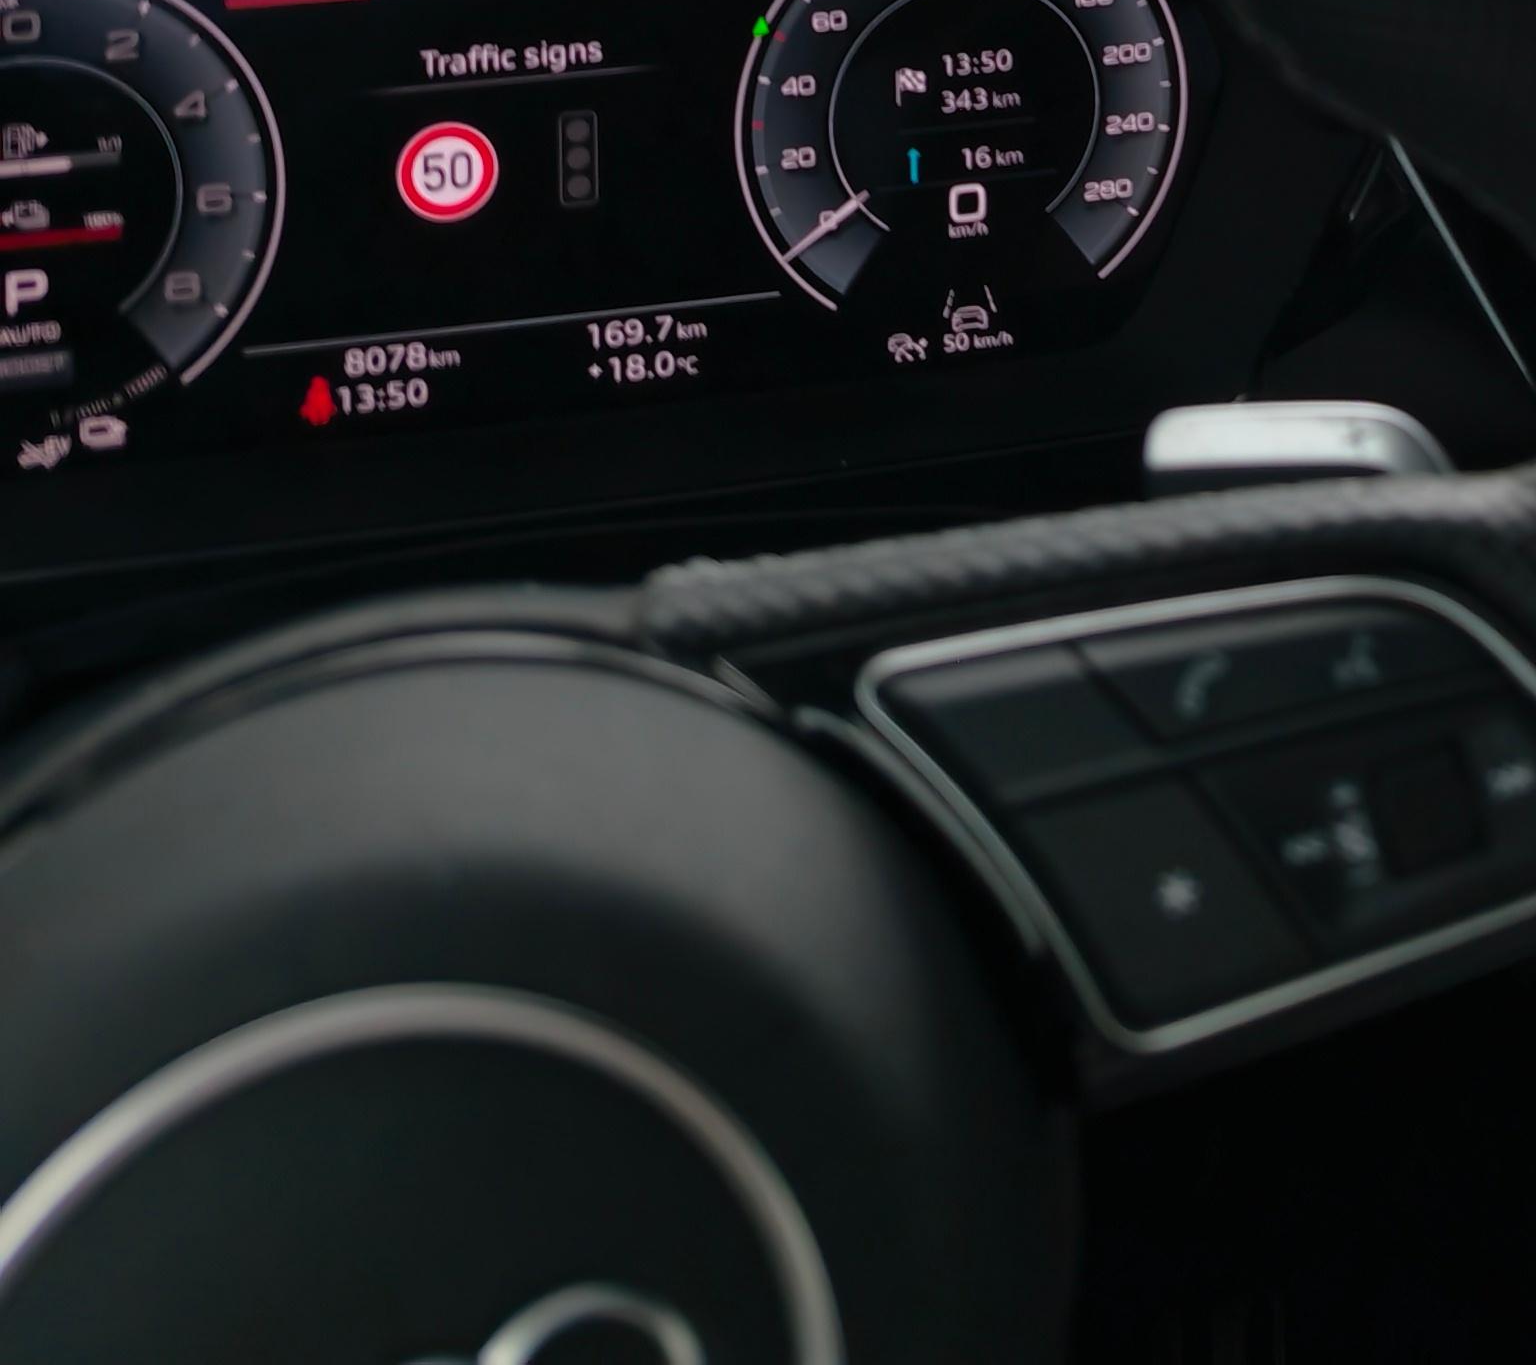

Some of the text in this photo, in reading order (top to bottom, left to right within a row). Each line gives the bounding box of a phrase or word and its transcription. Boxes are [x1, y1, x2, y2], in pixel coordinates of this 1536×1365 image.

[811, 10, 848, 32] 60
[104, 29, 140, 61] 2
[1103, 42, 1152, 65] 200
[420, 40, 603, 79] Traffic signs
[942, 48, 1013, 76] 13:50
[781, 76, 816, 97] 40
[174, 92, 206, 121] 4
[940, 88, 1021, 113] 343 km
[1105, 111, 1155, 135] 240
[781, 147, 816, 169] 20
[961, 147, 1024, 169] 16 km
[422, 151, 474, 193] 50
[948, 183, 987, 225] 0
[948, 222, 989, 240] km/h
[5, 268, 49, 317] P
[943, 328, 1014, 353] 50 km/h
[336, 378, 429, 415] 13:50
